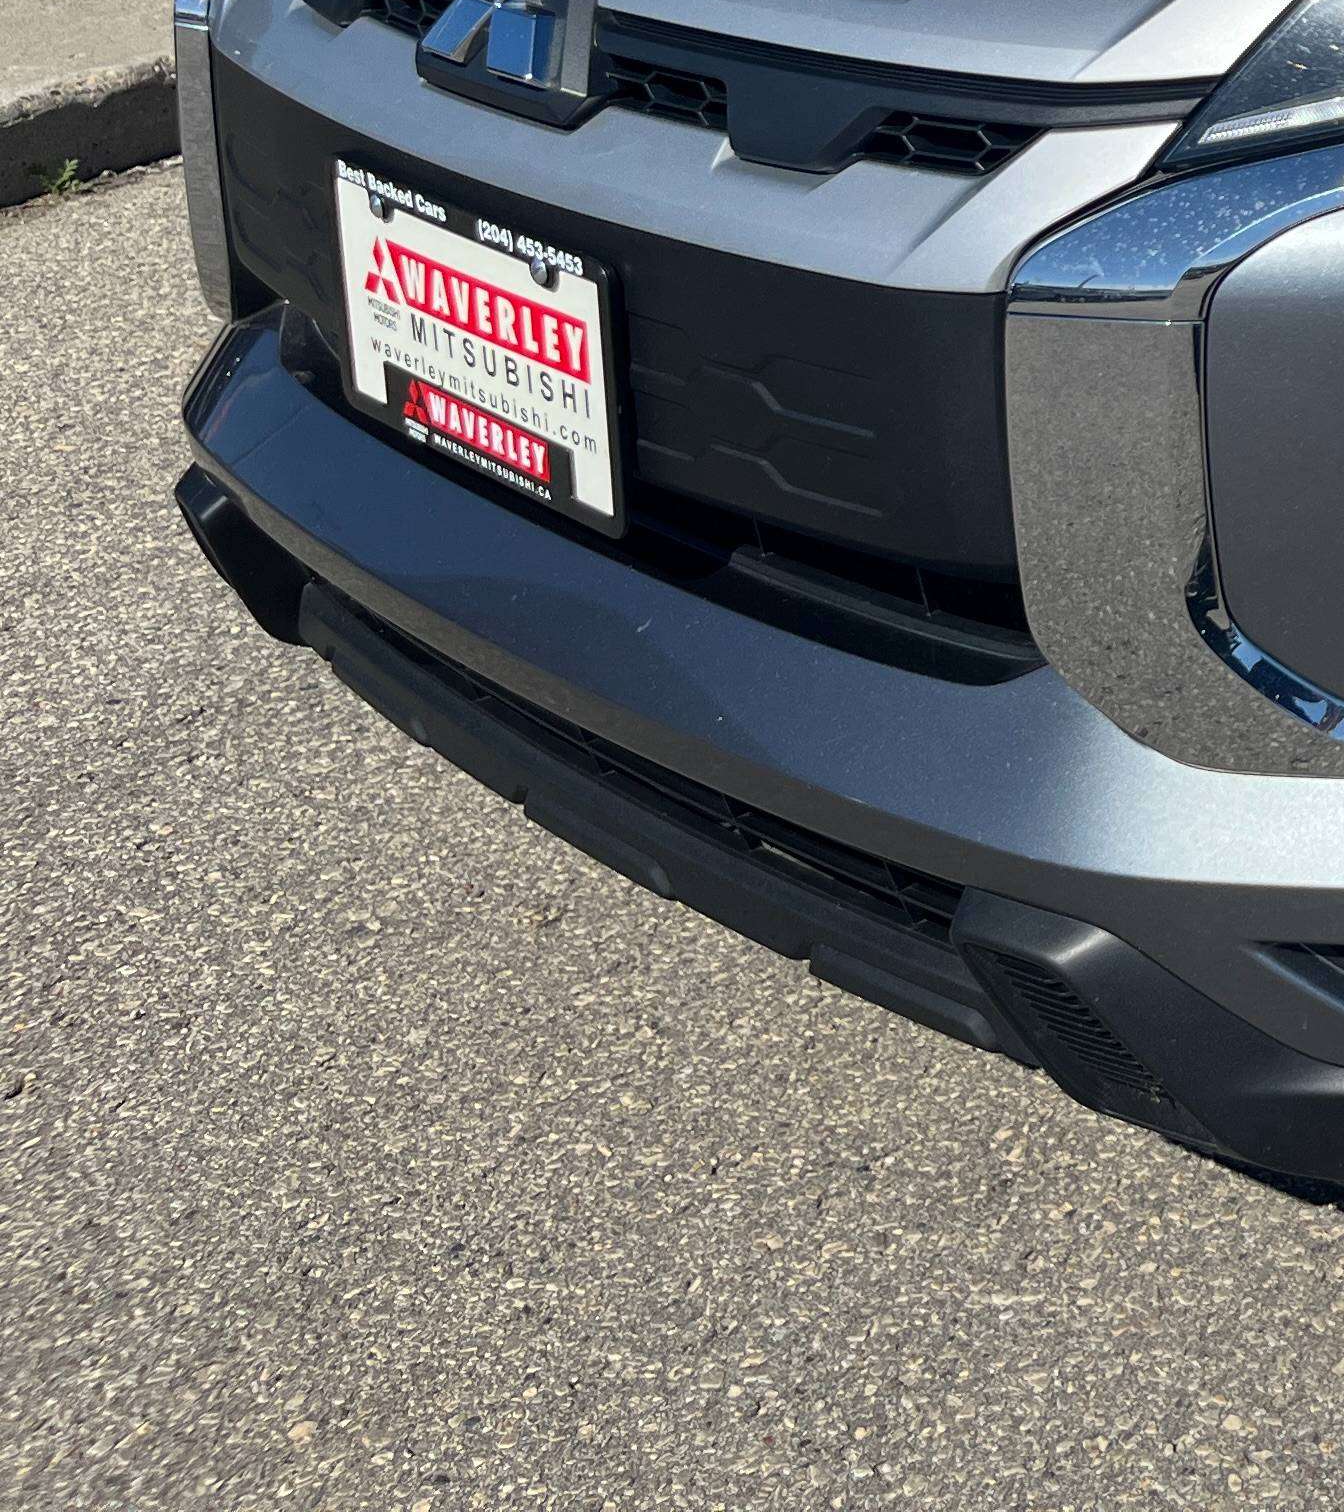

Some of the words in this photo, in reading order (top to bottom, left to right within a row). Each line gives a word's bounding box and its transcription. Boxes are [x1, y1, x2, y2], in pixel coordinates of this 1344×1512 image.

[337, 159, 367, 187] Best
[367, 171, 413, 208] Backed
[415, 193, 447, 222] Cars
[477, 218, 514, 253] (204)
[517, 235, 584, 276] 453-5453
[401, 253, 584, 372] WAVERLEY
[370, 335, 598, 455] waverleymitsubishi.com
[410, 313, 591, 419] MITSUBISHI
[429, 390, 546, 475] WAVERLEY
[433, 432, 552, 501] WAVERLEYMITSUBISHI.CA
